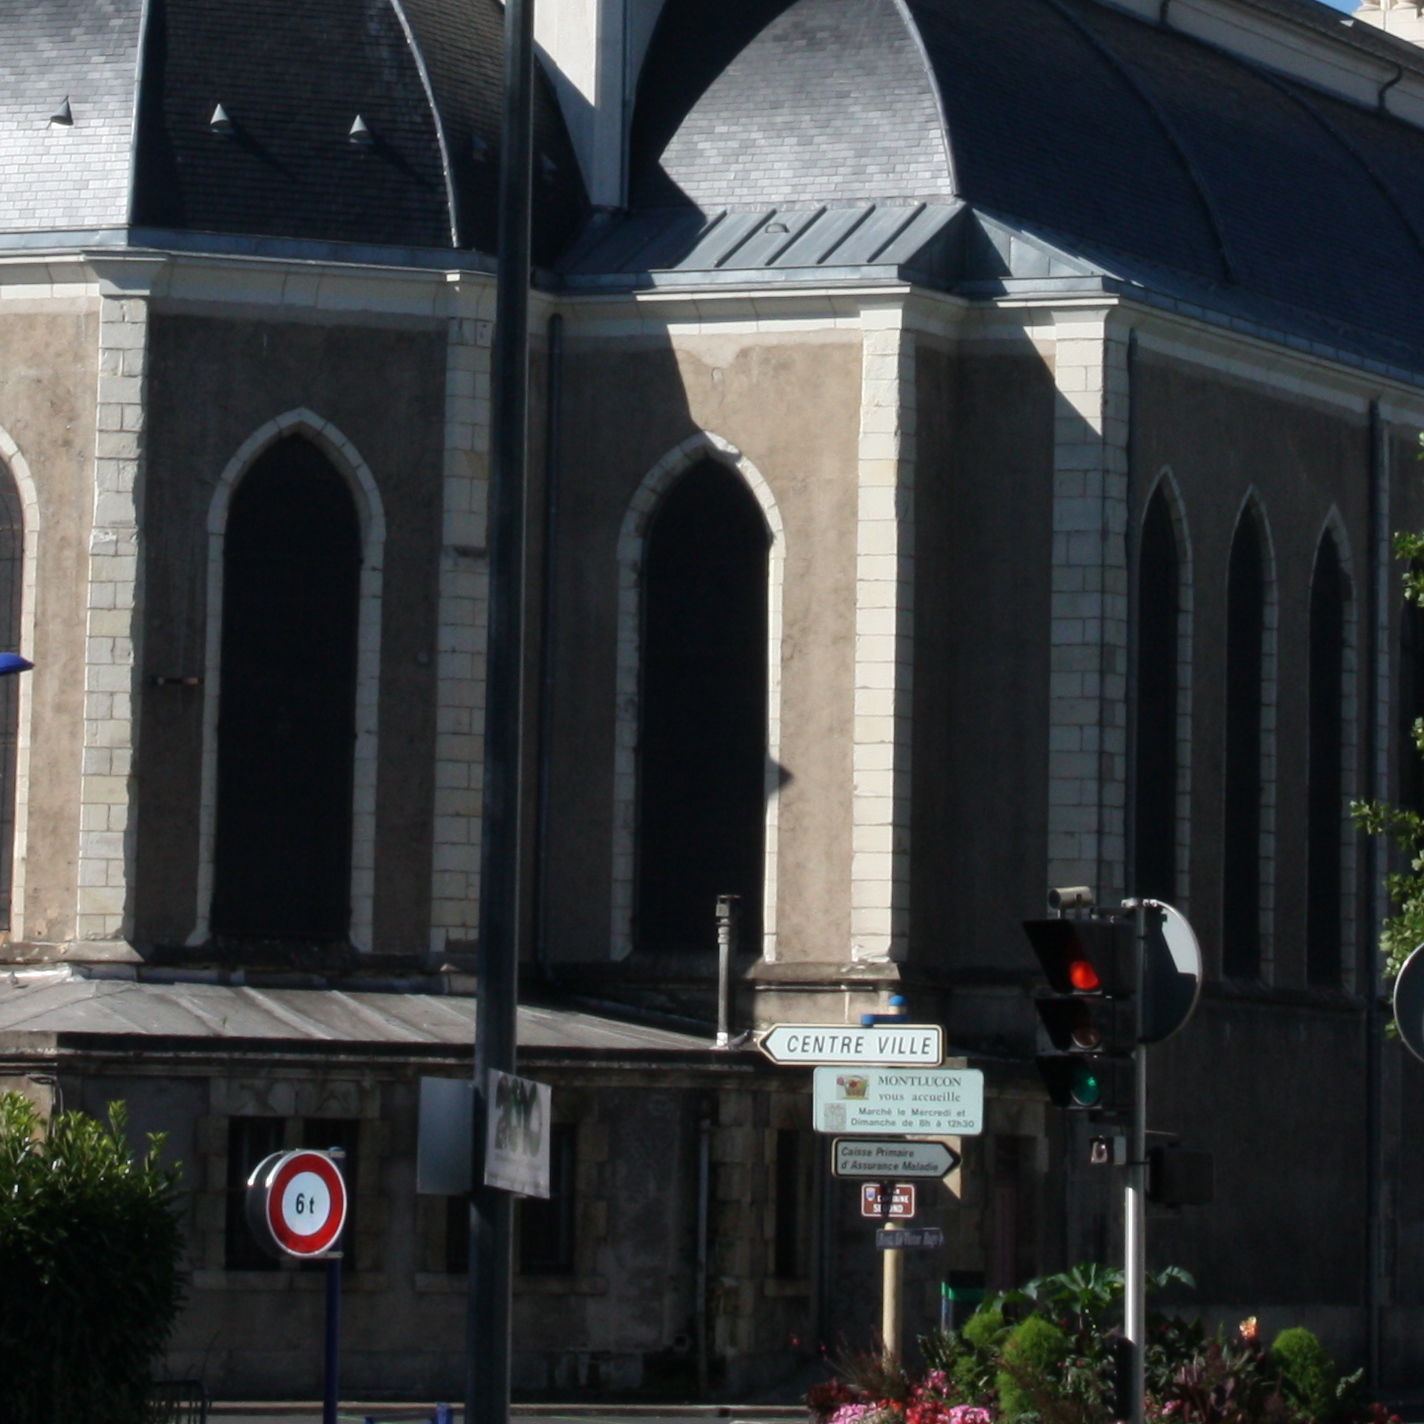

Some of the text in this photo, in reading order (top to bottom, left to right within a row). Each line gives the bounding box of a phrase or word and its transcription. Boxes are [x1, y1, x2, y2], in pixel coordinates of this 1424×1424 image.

[786, 1035, 932, 1055] CENTRE VILLE
[879, 1091, 961, 1103] vous accueille
[858, 1107, 966, 1117] Marché le Mercredi et
[850, 1118, 896, 1127] Dimanche
[901, 1119, 914, 1127] de
[947, 1119, 975, 1128] 12h30
[841, 1146, 915, 1158] Caisse Primaire
[902, 1161, 939, 1172] Maladie
